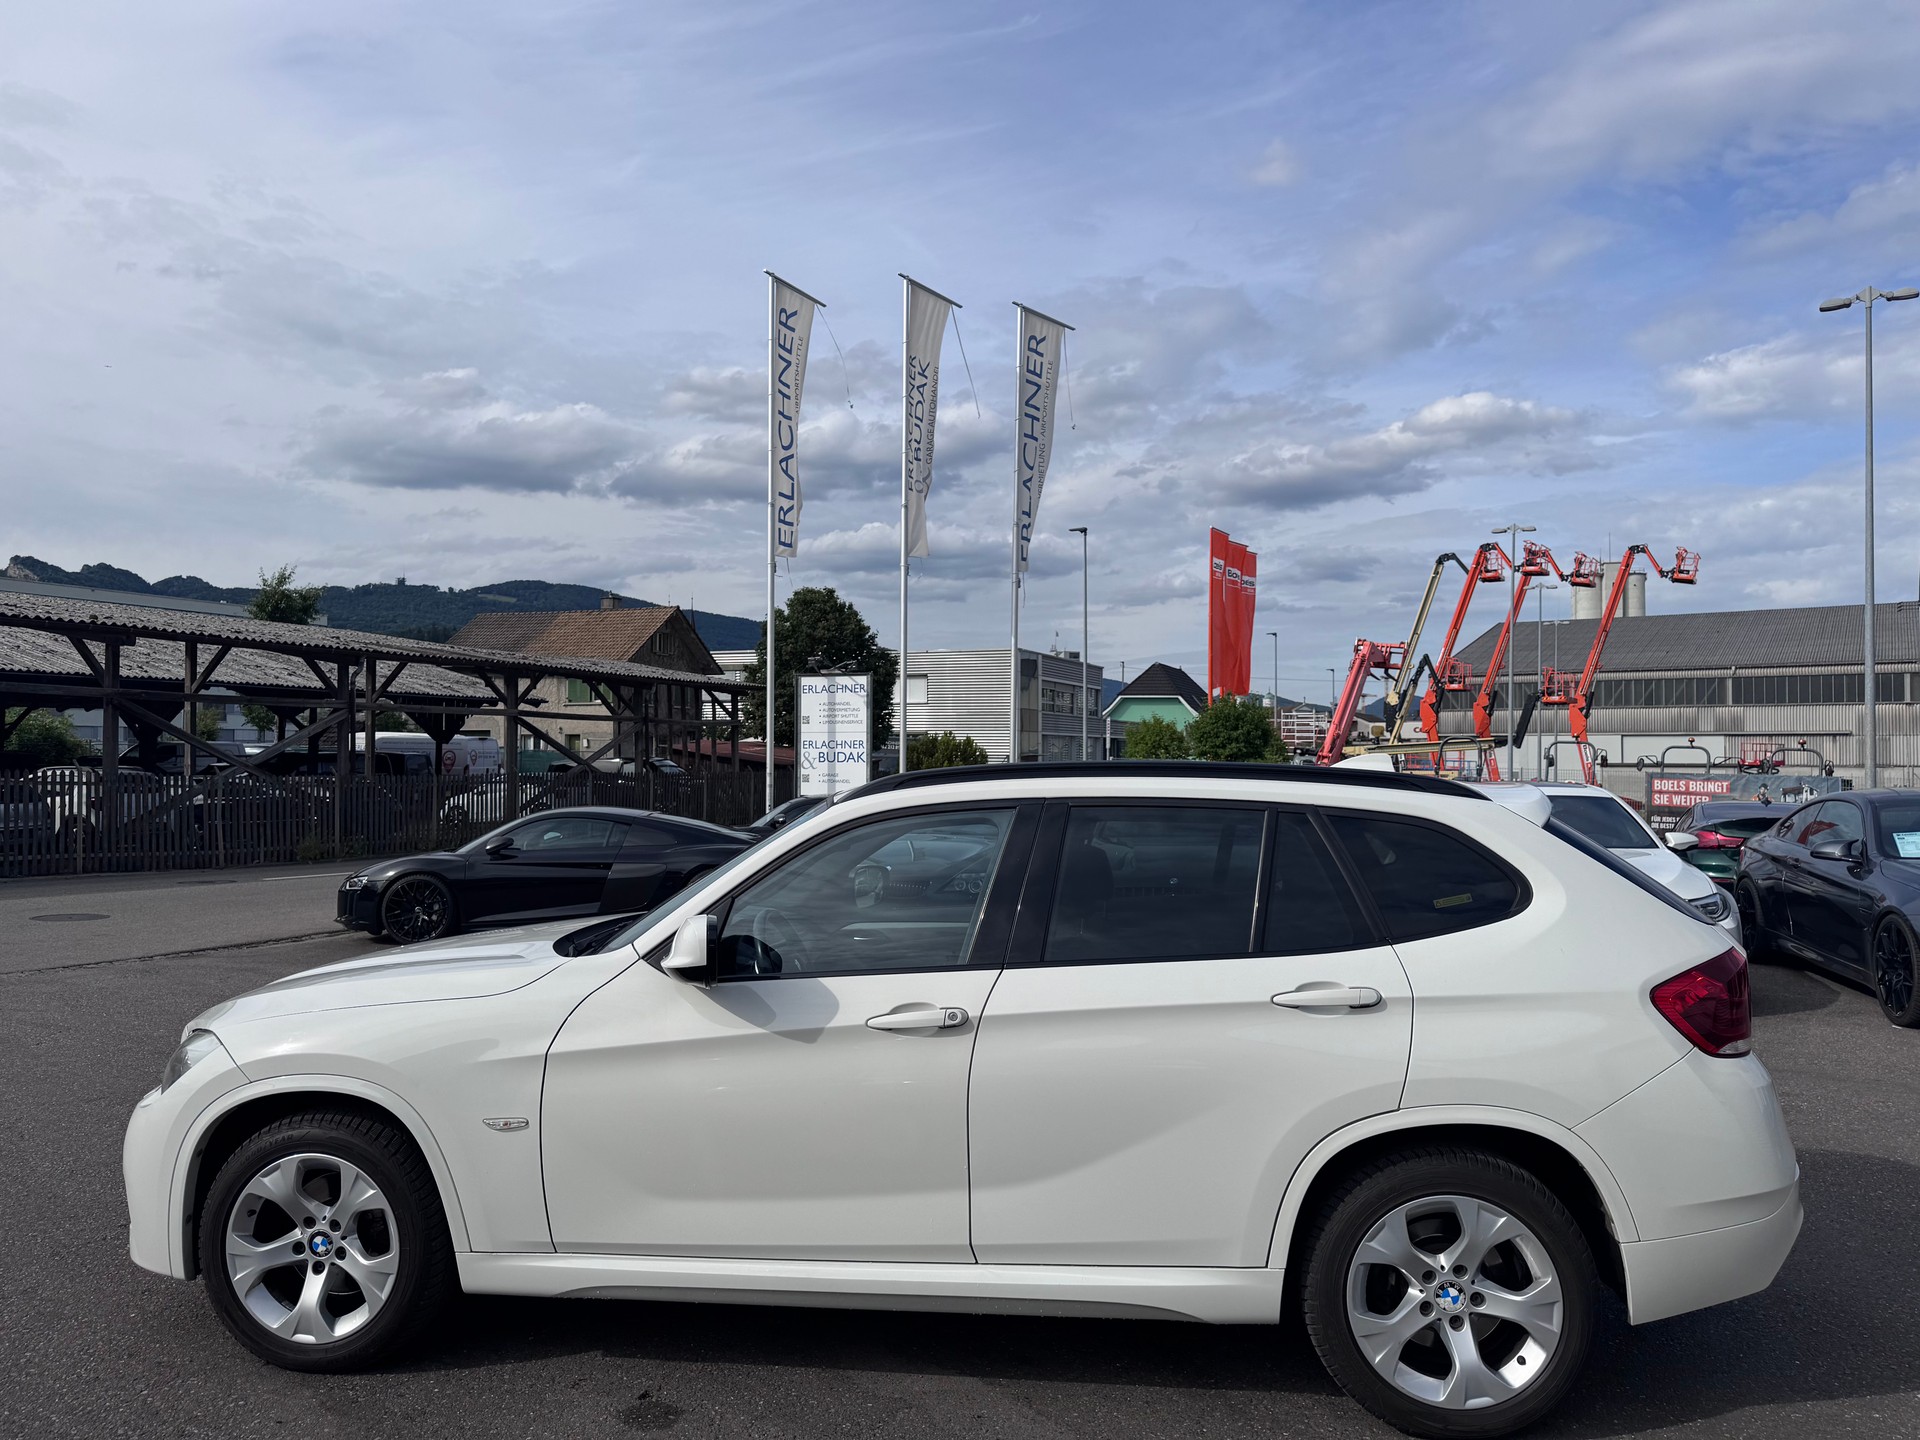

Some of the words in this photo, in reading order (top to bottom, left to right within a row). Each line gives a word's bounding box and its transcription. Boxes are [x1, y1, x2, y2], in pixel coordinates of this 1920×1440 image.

[914, 358, 931, 462] BUDAK
[778, 307, 798, 548] ERLACHNER
[926, 429, 936, 465] GARAGE
[802, 684, 866, 694] ERLACHNER
[802, 740, 865, 749] ERLACHNER
[802, 751, 818, 770] &
[818, 752, 866, 763] BUDAK
[1654, 780, 1686, 792] BOELS
[1689, 781, 1729, 792] BRINGT
[1654, 794, 1669, 804] SIE
[1672, 795, 1710, 806] WEITER
